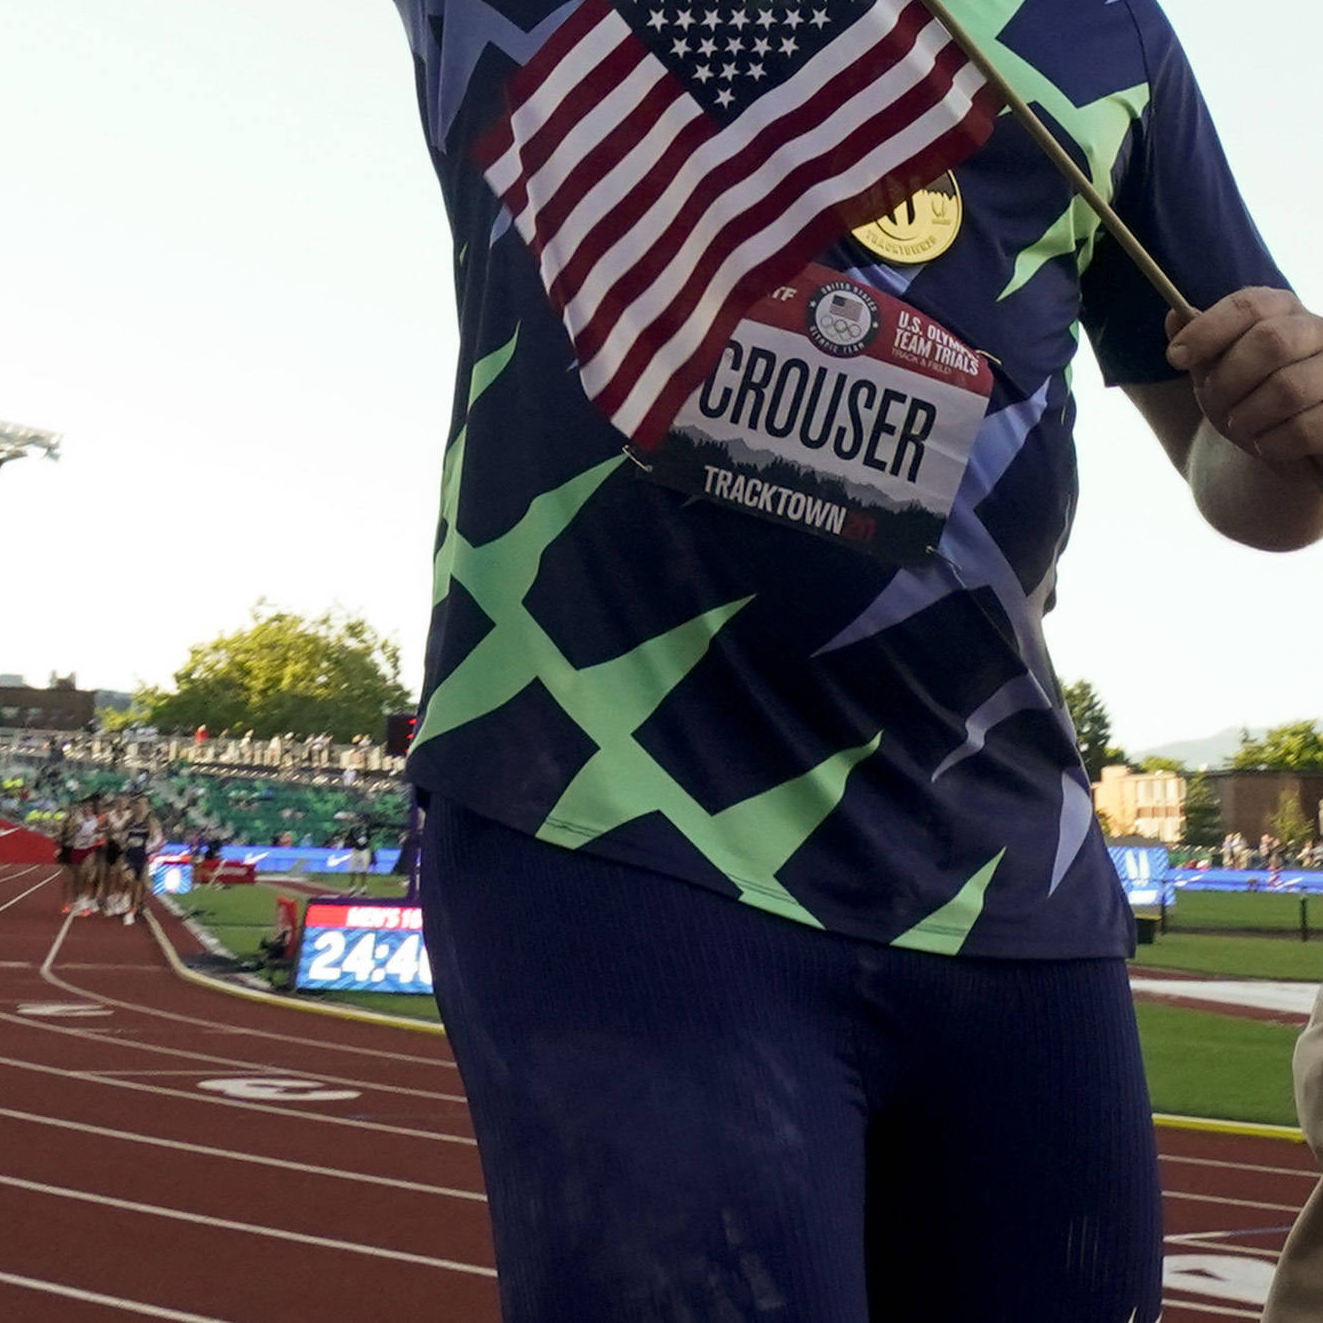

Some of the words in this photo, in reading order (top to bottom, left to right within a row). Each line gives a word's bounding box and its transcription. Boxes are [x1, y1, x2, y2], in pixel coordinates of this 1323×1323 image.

[898, 310, 923, 335] U.S.
[893, 328, 932, 358] TEAM
[934, 343, 979, 376] TRIALS
[698, 338, 937, 484] CROUSER
